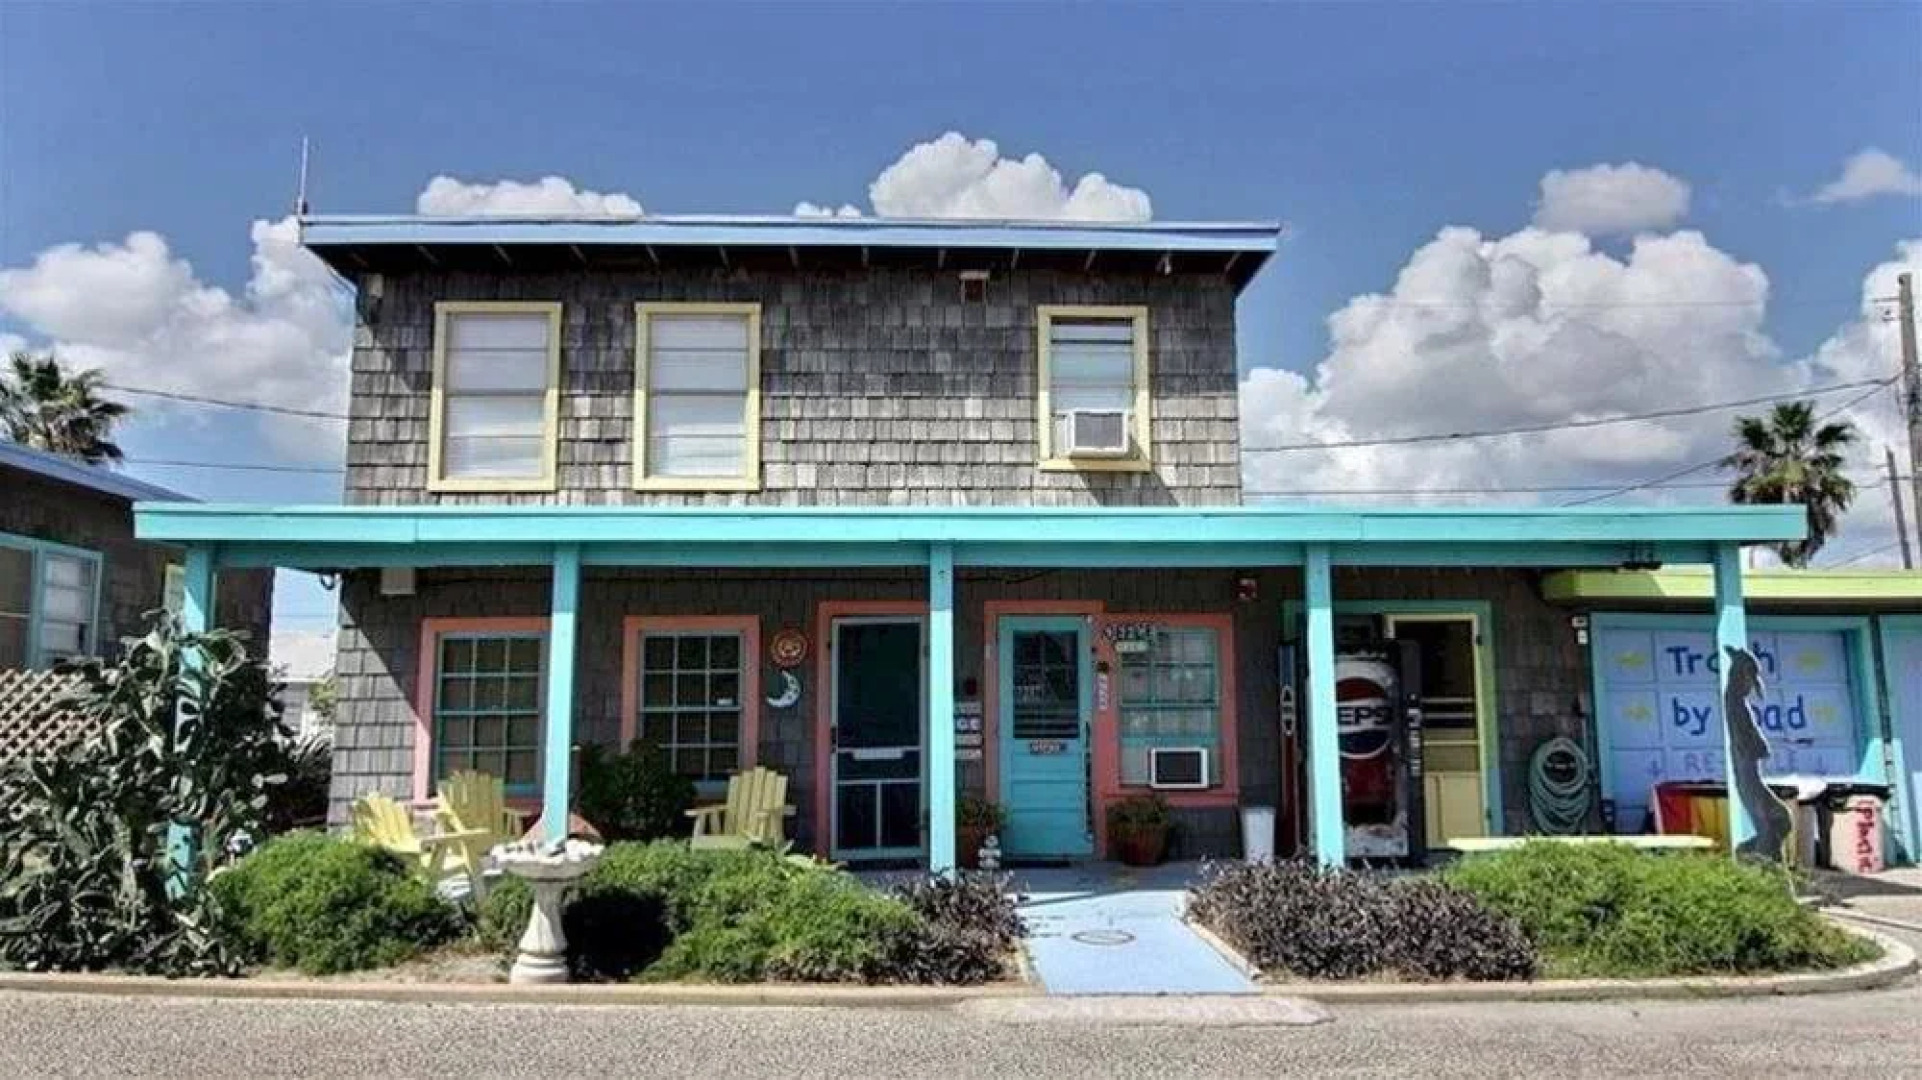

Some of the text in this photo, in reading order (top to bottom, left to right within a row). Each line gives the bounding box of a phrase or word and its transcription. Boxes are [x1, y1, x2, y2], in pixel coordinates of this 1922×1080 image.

[1666, 640, 1775, 675] Trah
[1672, 695, 1806, 736] by ad
